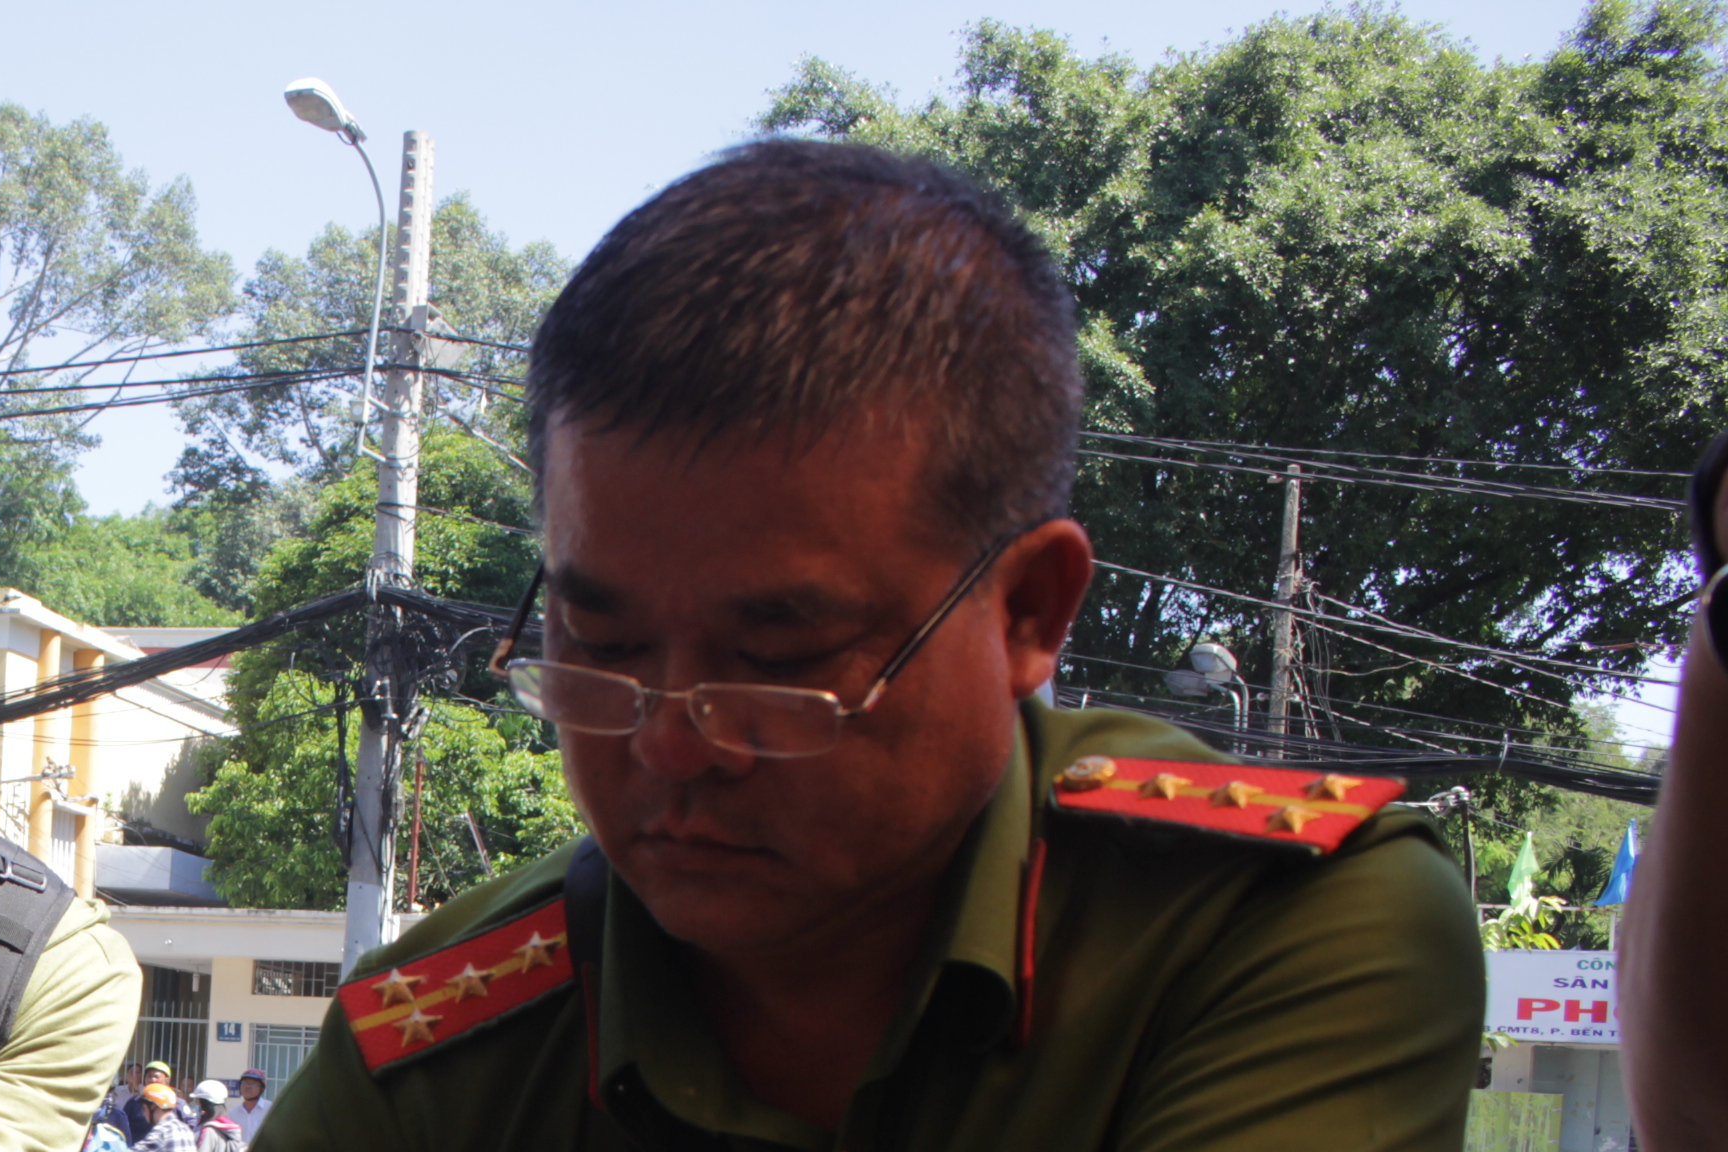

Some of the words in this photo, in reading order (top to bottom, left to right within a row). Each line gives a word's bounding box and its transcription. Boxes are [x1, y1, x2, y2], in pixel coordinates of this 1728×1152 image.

[1553, 976, 1609, 989] SÂN
[1517, 997, 1620, 1024] PH
[223, 1022, 236, 1036] 14
[1497, 1026, 1544, 1036] CMT8,
[1550, 1028, 1565, 1036] P.
[1571, 1026, 1603, 1037] BẾN
